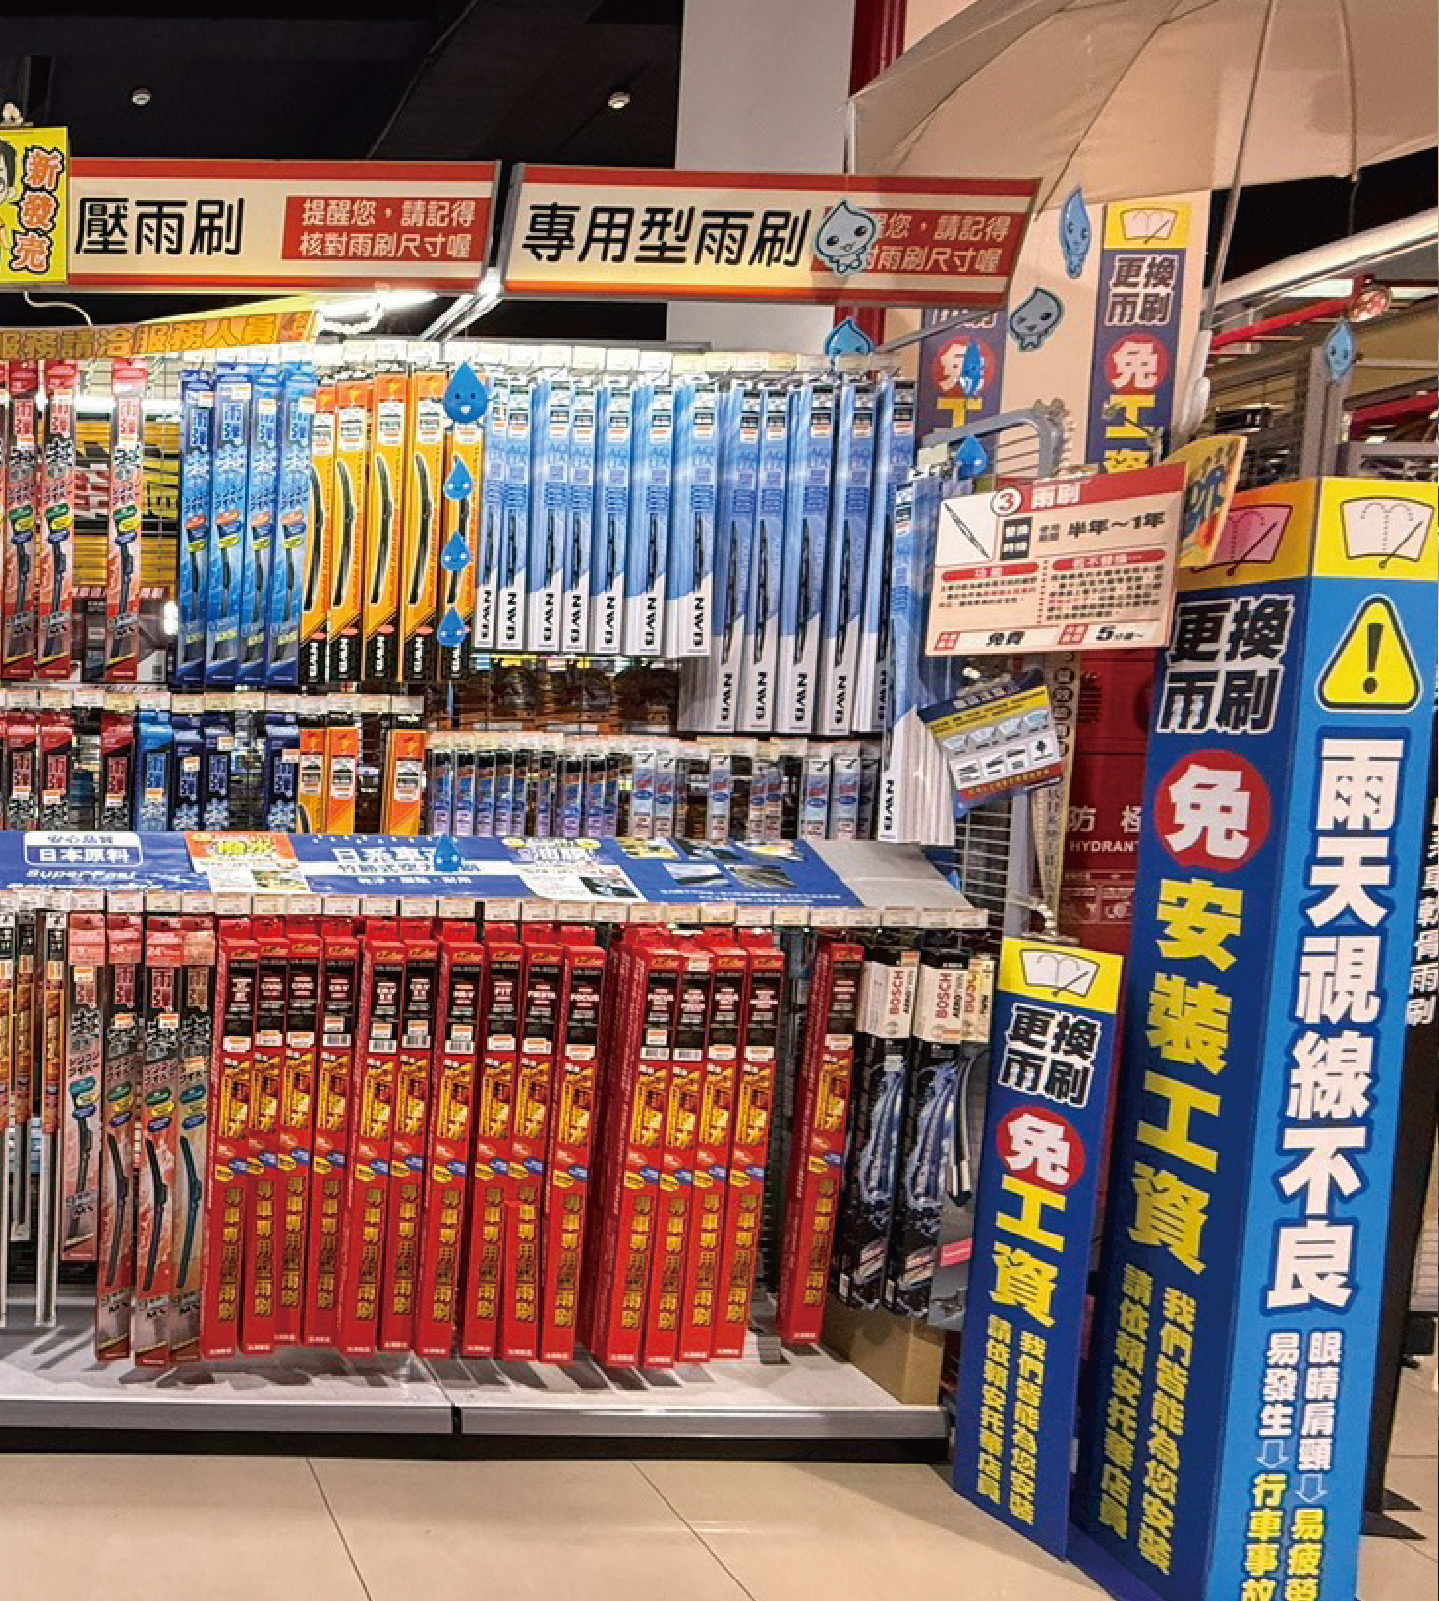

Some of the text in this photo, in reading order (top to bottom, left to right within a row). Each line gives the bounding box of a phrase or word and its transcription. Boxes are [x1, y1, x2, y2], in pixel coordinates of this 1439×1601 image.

[299, 232, 472, 260] 核對雨刷尺寸喔
[523, 202, 811, 268] 專用型雨刷
[1111, 253, 1178, 291] 更換
[1105, 289, 1173, 327] 雨刷
[1031, 484, 1081, 509] 雨刷
[1167, 594, 1297, 665] 更換
[1156, 662, 1283, 735] 雨刷
[1167, 764, 1253, 861] 免
[38, 847, 130, 863] 日本原料
[889, 970, 904, 1015] BOSCH
[935, 973, 952, 1020] BOSCH
[1267, 738, 1406, 1311] 雨天視線不良
[1009, 1004, 1101, 1060] 更換
[998, 1050, 1093, 1109] 雨刷
[1126, 878, 1245, 1275] 安裝工資
[1005, 1112, 1072, 1187] 免
[991, 1174, 1068, 1329] 工資
[1137, 1286, 1198, 1576] 我們皆能為您安裝
[1296, 1330, 1346, 1472] 眼睛肩頸
[1241, 1331, 1303, 1601] 易發生 行車事故
